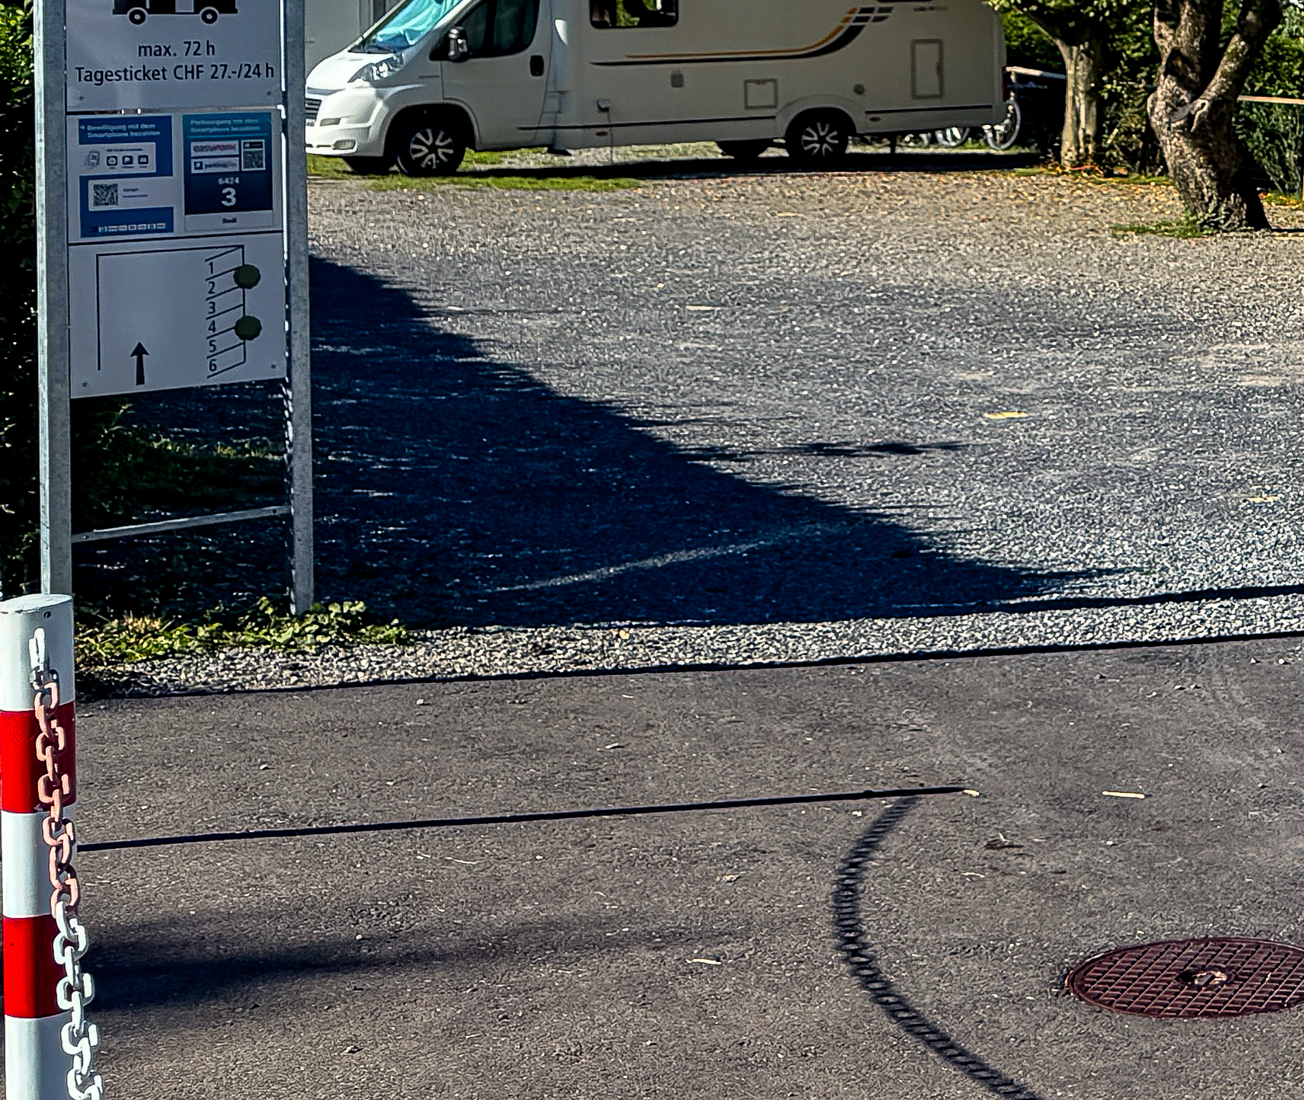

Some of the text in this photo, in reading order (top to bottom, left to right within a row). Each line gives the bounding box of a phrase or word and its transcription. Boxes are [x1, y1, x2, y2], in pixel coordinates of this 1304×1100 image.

[138, 40, 216, 57] max. 72 h
[75, 62, 275, 87] Tagesticket CHF 27.-/24 h
[221, 187, 237, 207] 3
[208, 261, 214, 274] 1
[207, 281, 216, 294] 2
[208, 301, 216, 314] 3
[208, 320, 216, 333] 4
[208, 340, 217, 353] 5
[209, 359, 217, 372] 6
